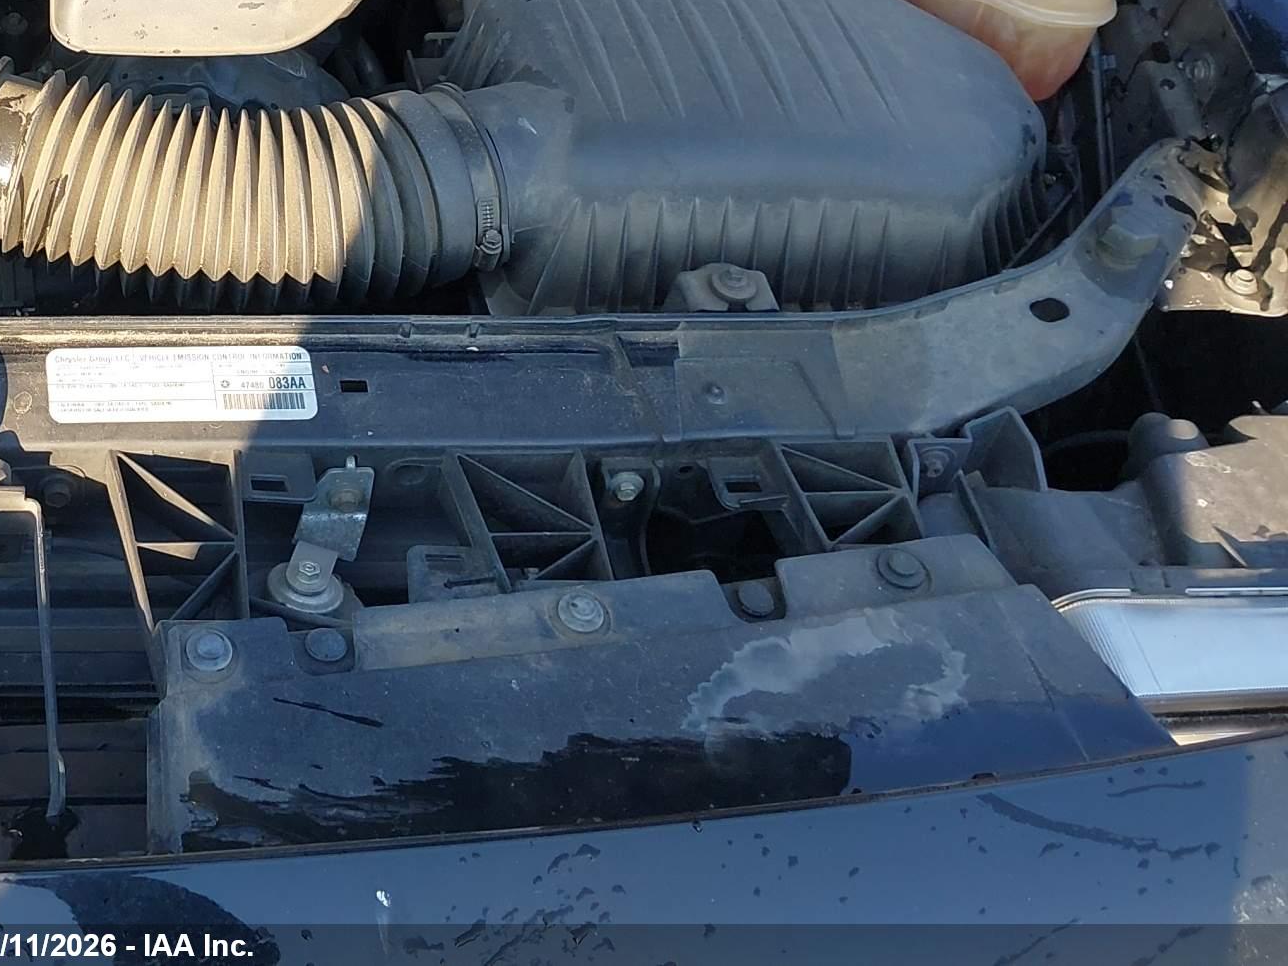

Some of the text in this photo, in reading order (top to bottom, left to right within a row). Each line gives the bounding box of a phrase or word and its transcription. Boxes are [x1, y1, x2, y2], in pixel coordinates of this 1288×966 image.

[173, 353, 209, 362] EMISSION
[249, 352, 302, 361] INFORMATION
[268, 376, 307, 389] 083AA
